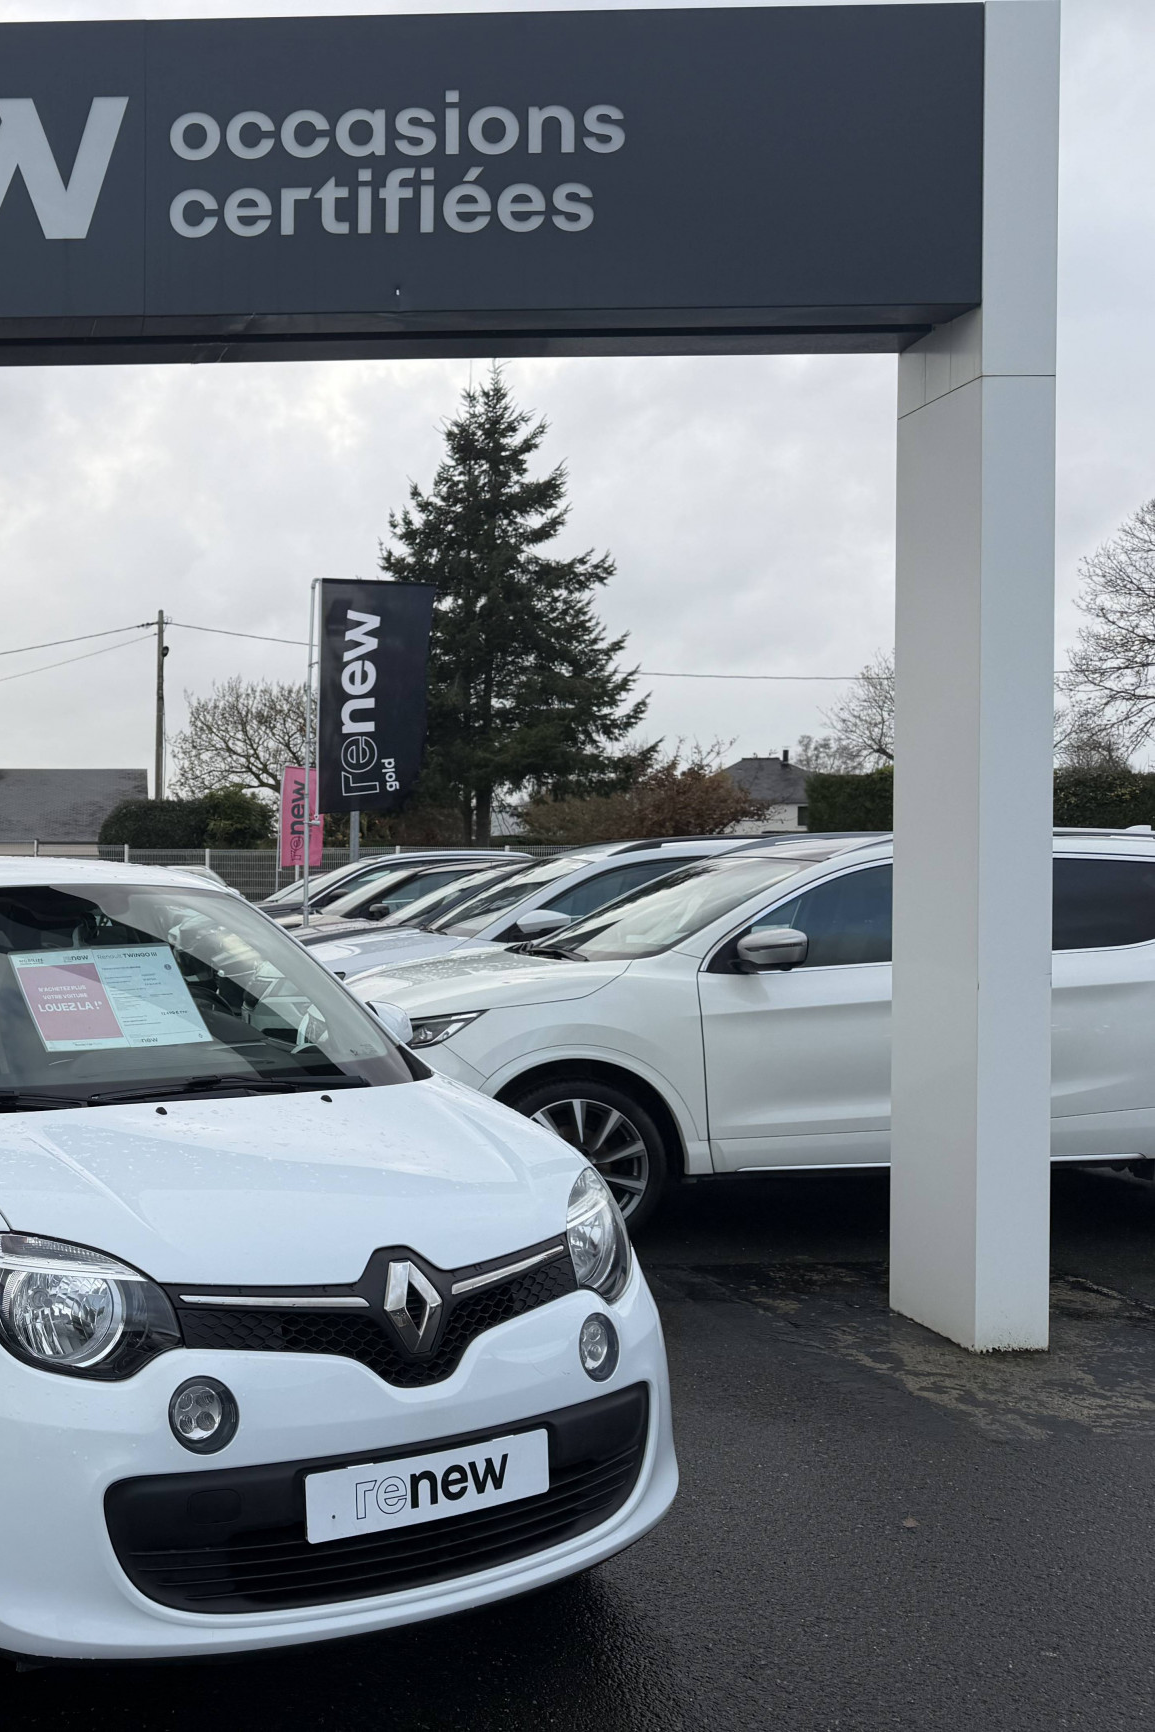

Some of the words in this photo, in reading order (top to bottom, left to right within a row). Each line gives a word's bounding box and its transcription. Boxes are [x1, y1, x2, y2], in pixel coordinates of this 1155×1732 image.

[169, 89, 626, 161] occasions
[169, 166, 595, 238] certifiées
[341, 609, 382, 797] renew
[381, 757, 400, 792] gold
[290, 779, 306, 861] renew
[38, 1002, 77, 1012] LOUEZ
[77, 1001, 94, 1010] LA
[355, 1453, 509, 1520] renew
